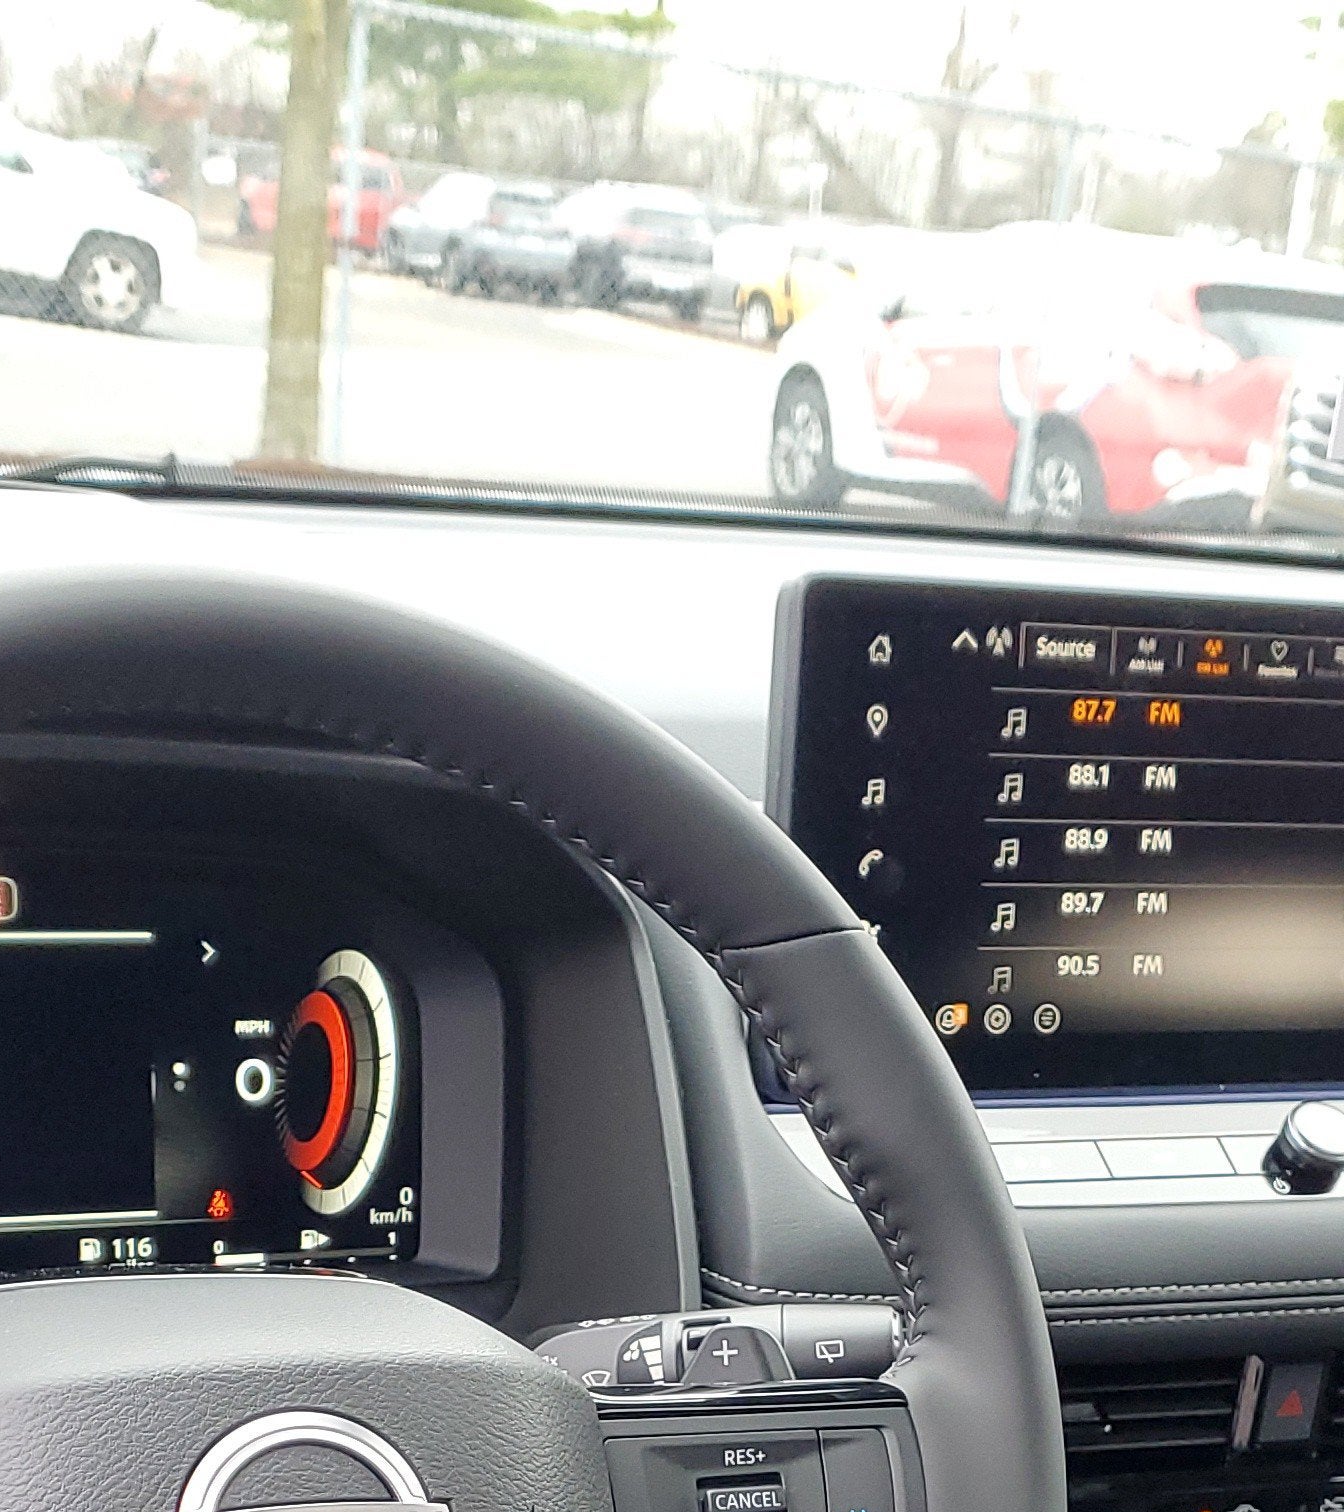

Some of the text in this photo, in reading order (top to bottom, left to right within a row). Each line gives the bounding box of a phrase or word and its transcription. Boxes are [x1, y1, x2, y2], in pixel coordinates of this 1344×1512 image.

[1036, 635, 1097, 658] Source
[1072, 699, 1182, 726] 87.7 FM
[1068, 763, 1176, 789] 88.1 FM
[1064, 828, 1172, 852] 88.9 FM
[1060, 892, 1168, 914] 89.7 FM
[1057, 954, 1163, 976] 90.5 FM
[234, 1019, 271, 1035] MPH
[235, 1057, 273, 1102] 0
[398, 1186, 414, 1206] 0
[369, 1208, 414, 1226] km/h
[112, 1237, 153, 1261] 116
[212, 1240, 225, 1256] 0
[388, 1231, 398, 1246] 1
[723, 1448, 767, 1467] RES+
[714, 1490, 782, 1511] CANCEL
